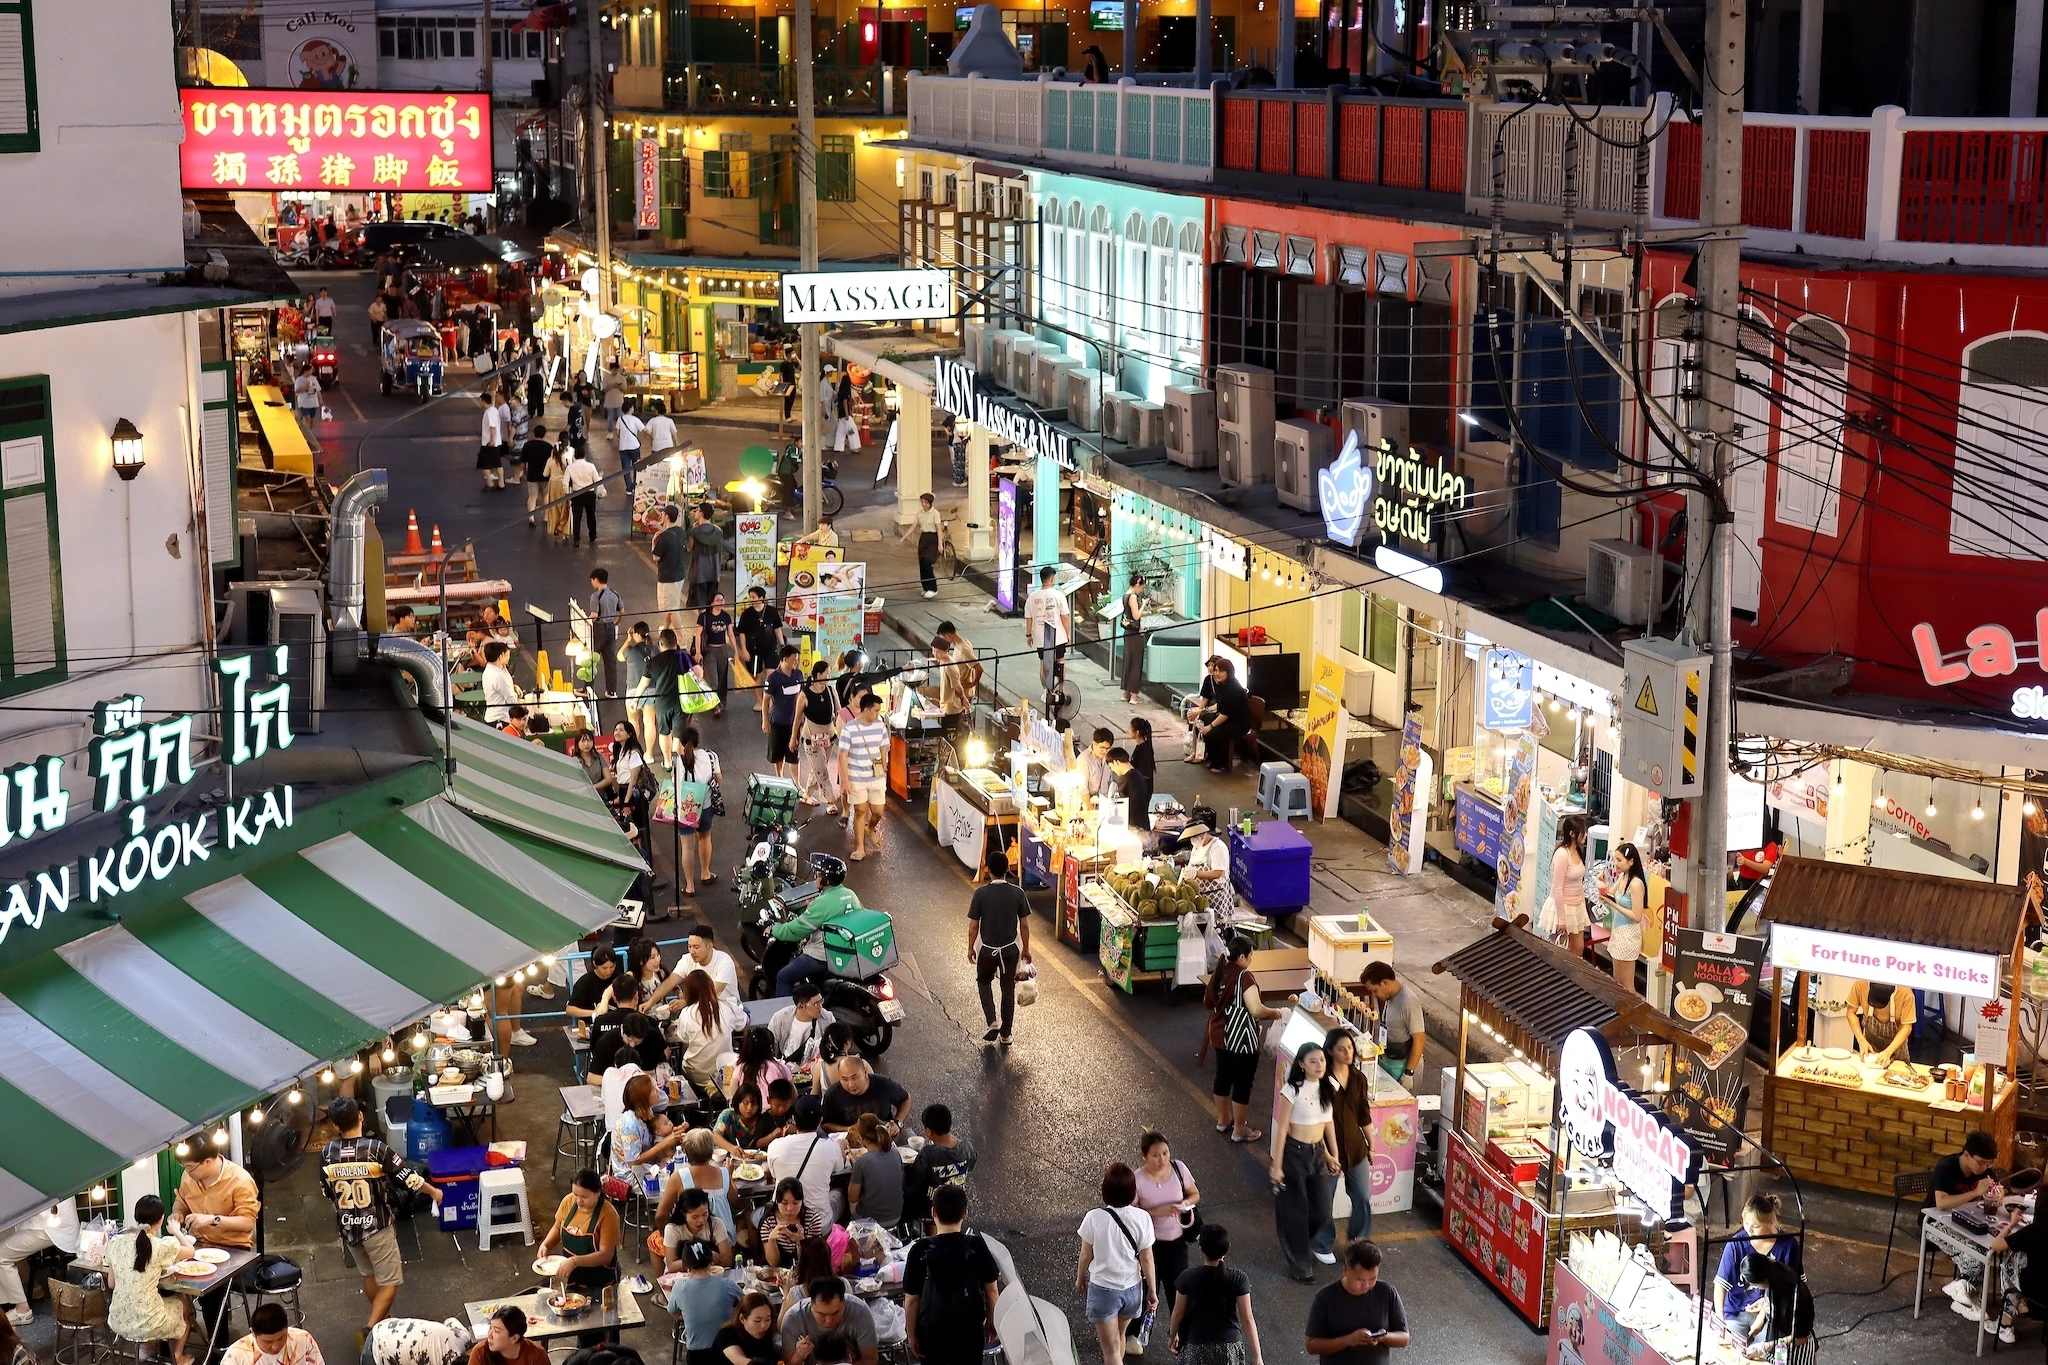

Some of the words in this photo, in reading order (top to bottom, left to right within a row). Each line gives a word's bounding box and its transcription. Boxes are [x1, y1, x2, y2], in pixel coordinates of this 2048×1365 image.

[323, 11, 356, 34] Moo
[640, 211, 658, 227] 14
[787, 283, 946, 313] MASSAGE
[934, 355, 974, 422] MSN
[1376, 437, 1465, 509] ข้าวต้มปลา
[1375, 497, 1435, 546] อุษณีย์
[1911, 621, 2018, 687] La
[1886, 798, 1931, 842] Corner
[89, 813, 210, 903] KOOK
[227, 784, 293, 849] KAI
[1693, 971, 1734, 984] NOODLES
[1697, 961, 1732, 977] MALA
[1811, 944, 1880, 967] Fortune
[1886, 955, 1927, 975] Pork
[1933, 963, 1989, 985] Sticks
[1733, 992, 1748, 1006] 85
[1603, 1086, 1687, 1175] NOUGAT
[331, 1165, 369, 1177] THAILAND
[335, 1179, 371, 1210] 20
[341, 1213, 375, 1227] Chang
